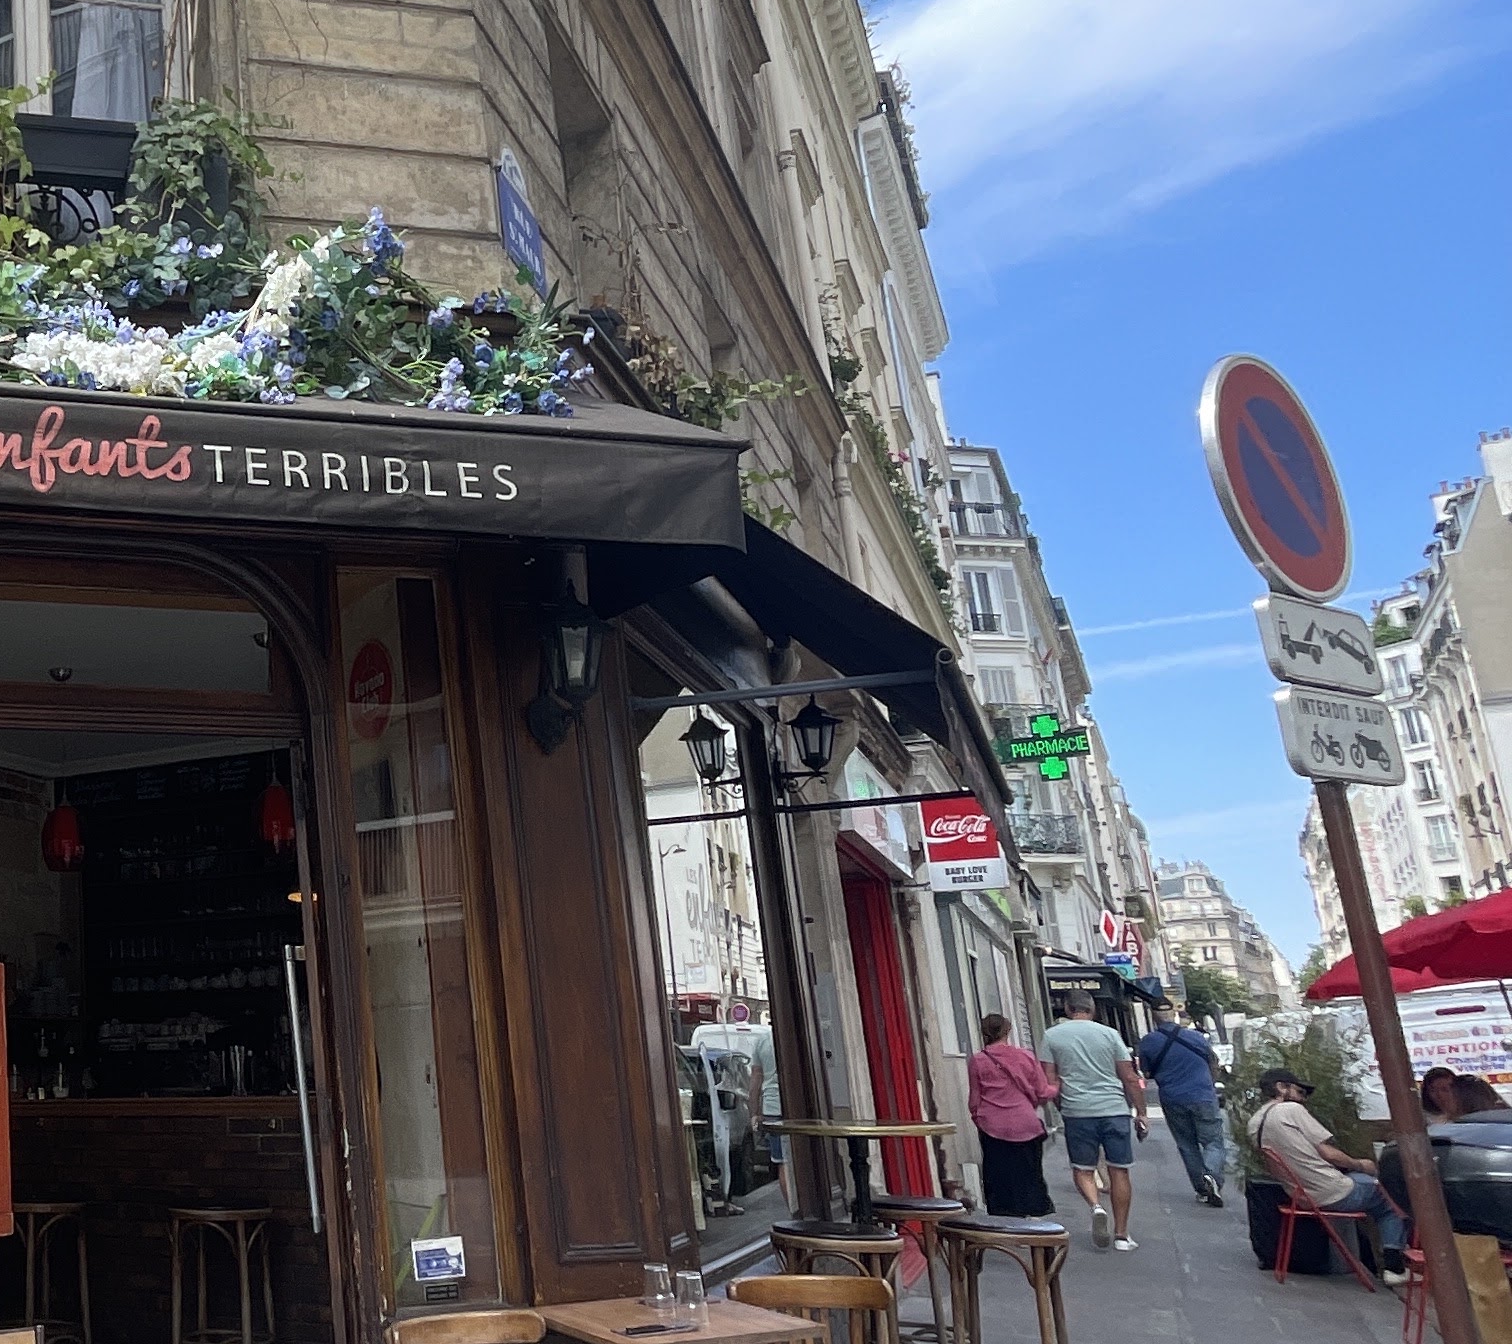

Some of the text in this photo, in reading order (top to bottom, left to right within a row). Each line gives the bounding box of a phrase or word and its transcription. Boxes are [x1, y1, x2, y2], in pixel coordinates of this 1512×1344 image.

[202, 444, 519, 501] TERRIBLES
[1297, 697, 1385, 726] INTERDIT SAUF
[1010, 734, 1089, 759] PHARMACIE
[968, 865, 988, 875] LOVE
[1413, 1041, 1498, 1057] RVENTION
